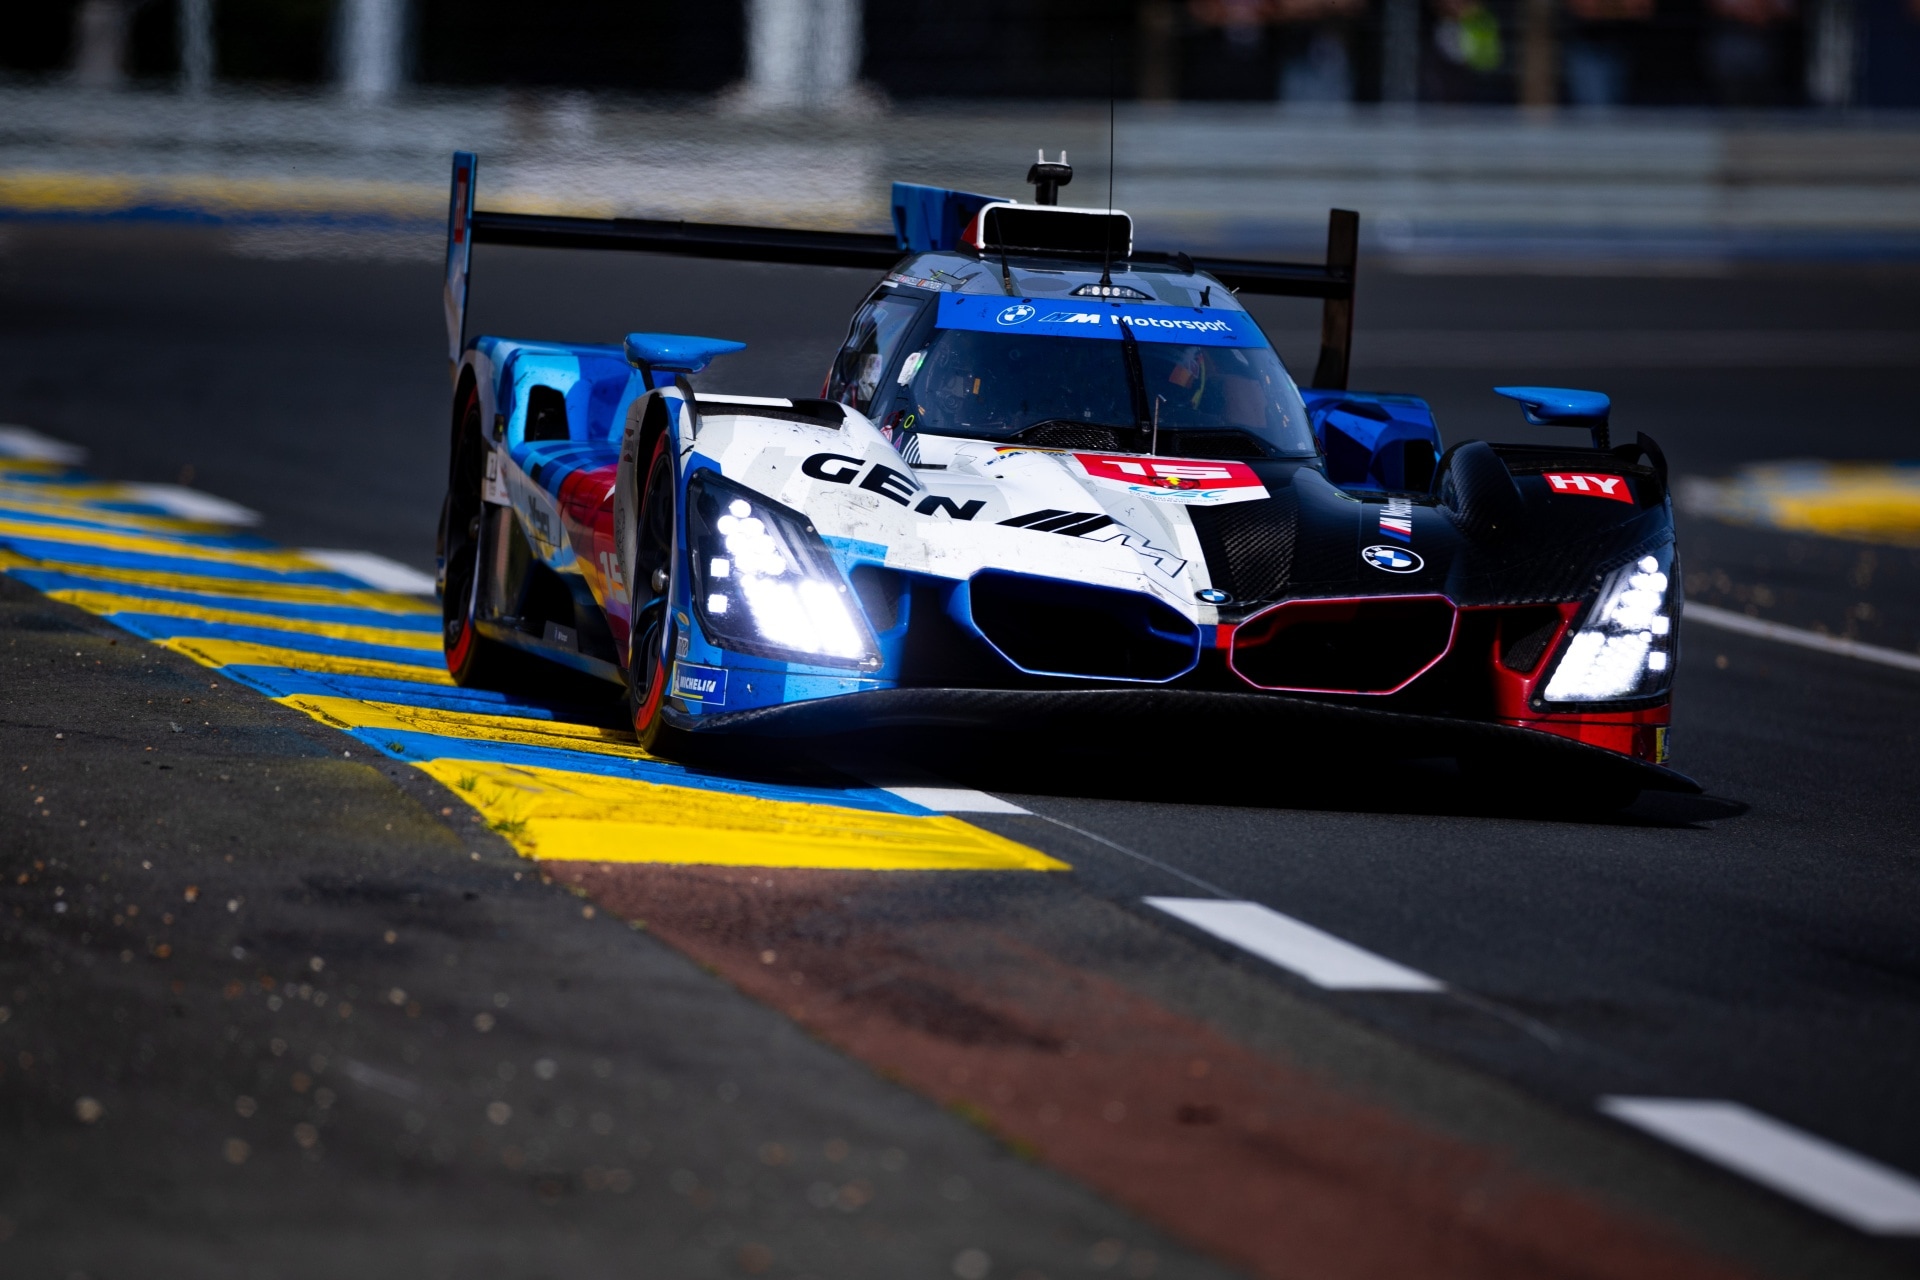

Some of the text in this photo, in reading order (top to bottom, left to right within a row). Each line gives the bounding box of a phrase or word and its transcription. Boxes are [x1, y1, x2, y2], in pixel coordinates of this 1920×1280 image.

[1110, 314, 1233, 332] Motorsport
[1101, 460, 1233, 480] 15
[801, 452, 987, 521] GEN
[1548, 475, 1620, 495] HY
[680, 675, 717, 693] MICHELIN
